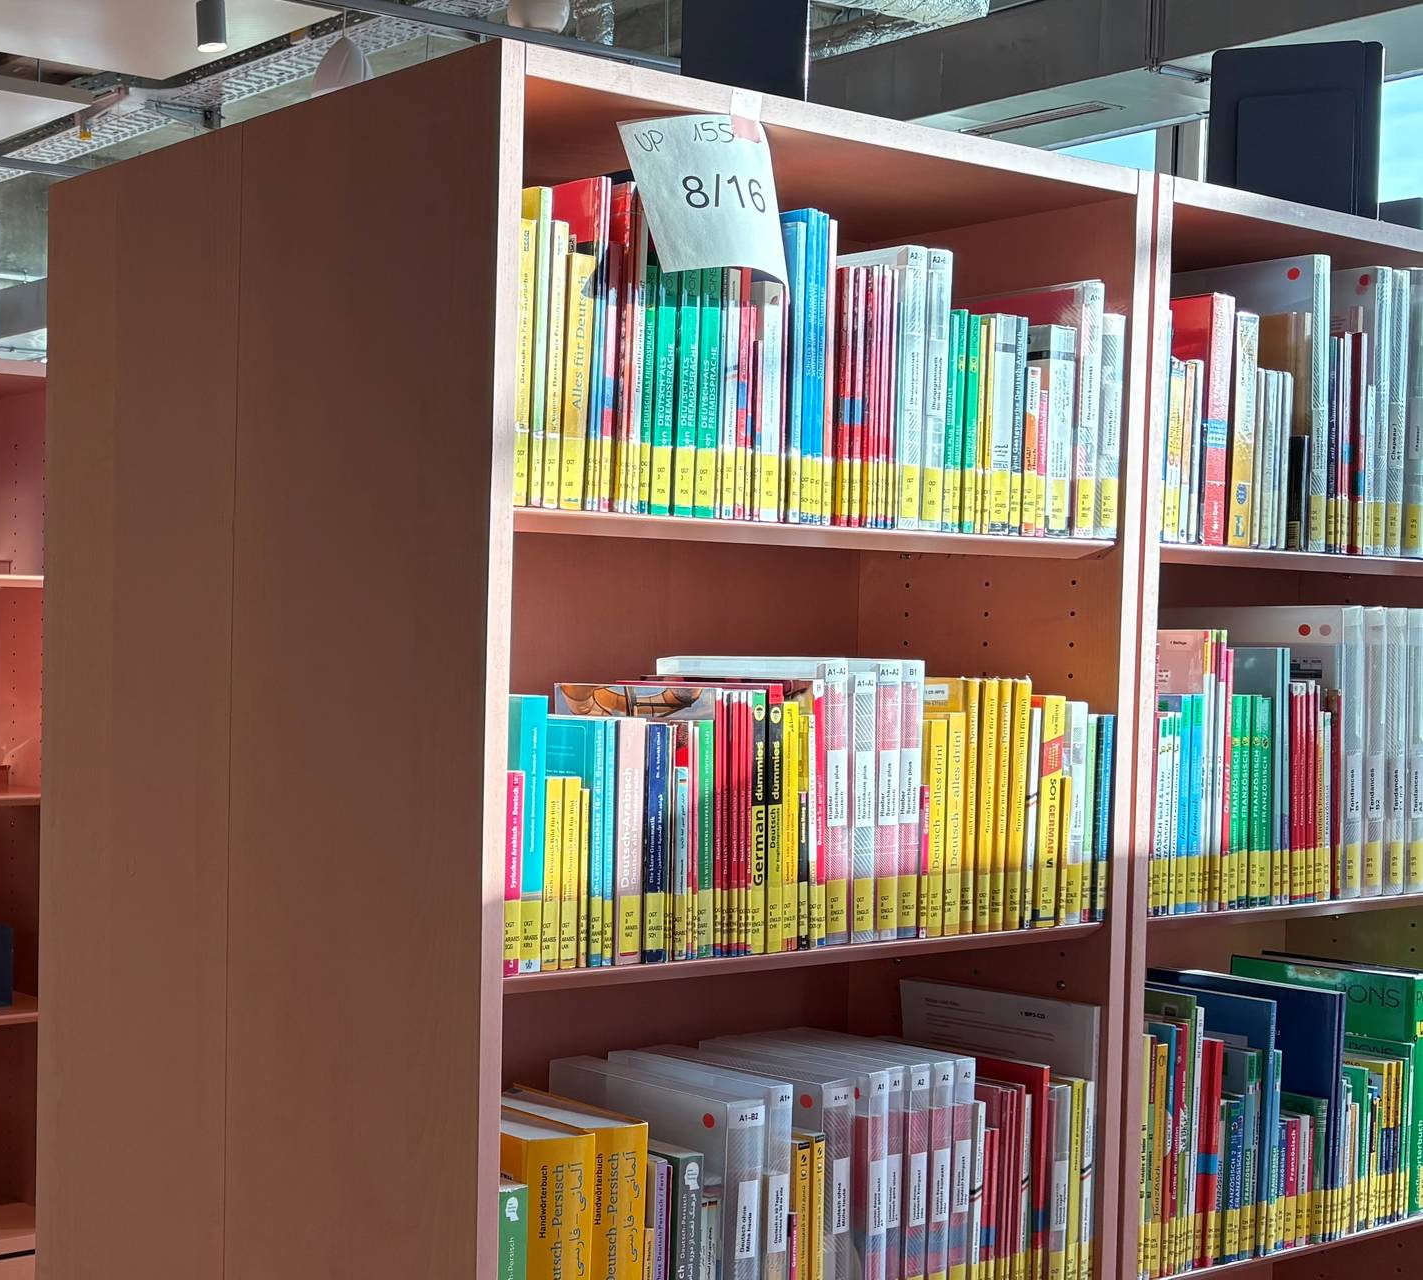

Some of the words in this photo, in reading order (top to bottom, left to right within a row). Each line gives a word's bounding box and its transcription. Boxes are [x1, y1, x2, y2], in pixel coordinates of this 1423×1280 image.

[634, 129, 664, 153] UP
[682, 173, 766, 213] 8/16
[665, 272, 674, 296] PON
[687, 270, 697, 296] PON
[574, 345, 585, 366] für
[645, 321, 653, 376] FREMDSPRACHE
[659, 356, 667, 376] ALS
[1015, 331, 1023, 400] Deutsch-Arabisch
[571, 371, 583, 411] Alles
[657, 378, 667, 426] DEUTSCH
[665, 343, 675, 426] FREMDSPRACHE
[681, 378, 689, 426] DEUTSCH
[687, 344, 697, 427] FREMDSPRACHE
[709, 346, 717, 429] FREMDSPRACHE
[701, 382, 709, 428] DEUTSCH
[909, 668, 917, 676] B1
[595, 730, 603, 778] Gymnasien
[935, 744, 943, 774] drin!
[953, 730, 961, 763] drin!
[771, 740, 780, 799] dummies
[952, 766, 961, 797] alles
[1049, 778, 1057, 800] 501
[511, 788, 519, 815] Deutsch
[933, 778, 942, 806] alles
[1375, 800, 1380, 810] B2
[511, 826, 519, 855] Arabisch
[621, 768, 633, 888] Deutsch-Arabisch
[753, 810, 765, 886] German
[769, 808, 777, 848] Deutsch
[933, 819, 941, 869] Deutsch
[949, 812, 959, 868] Deutsch
[1047, 804, 1056, 854] GERMAN
[1335, 982, 1400, 1008] PONS
[739, 1113, 759, 1123] A1-B2
[779, 1094, 790, 1102] A1+
[539, 1165, 548, 1238] Handwörterbuch
[551, 1164, 564, 1226] Persisch
[595, 1154, 603, 1226] Handwörterbuch
[607, 1152, 619, 1214] Persisch
[679, 1194, 687, 1259] Deutsch-Persisch
[739, 1224, 747, 1253] Deutsch
[507, 1237, 515, 1280] h-Persisch
[551, 1242, 562, 1280] utsch
